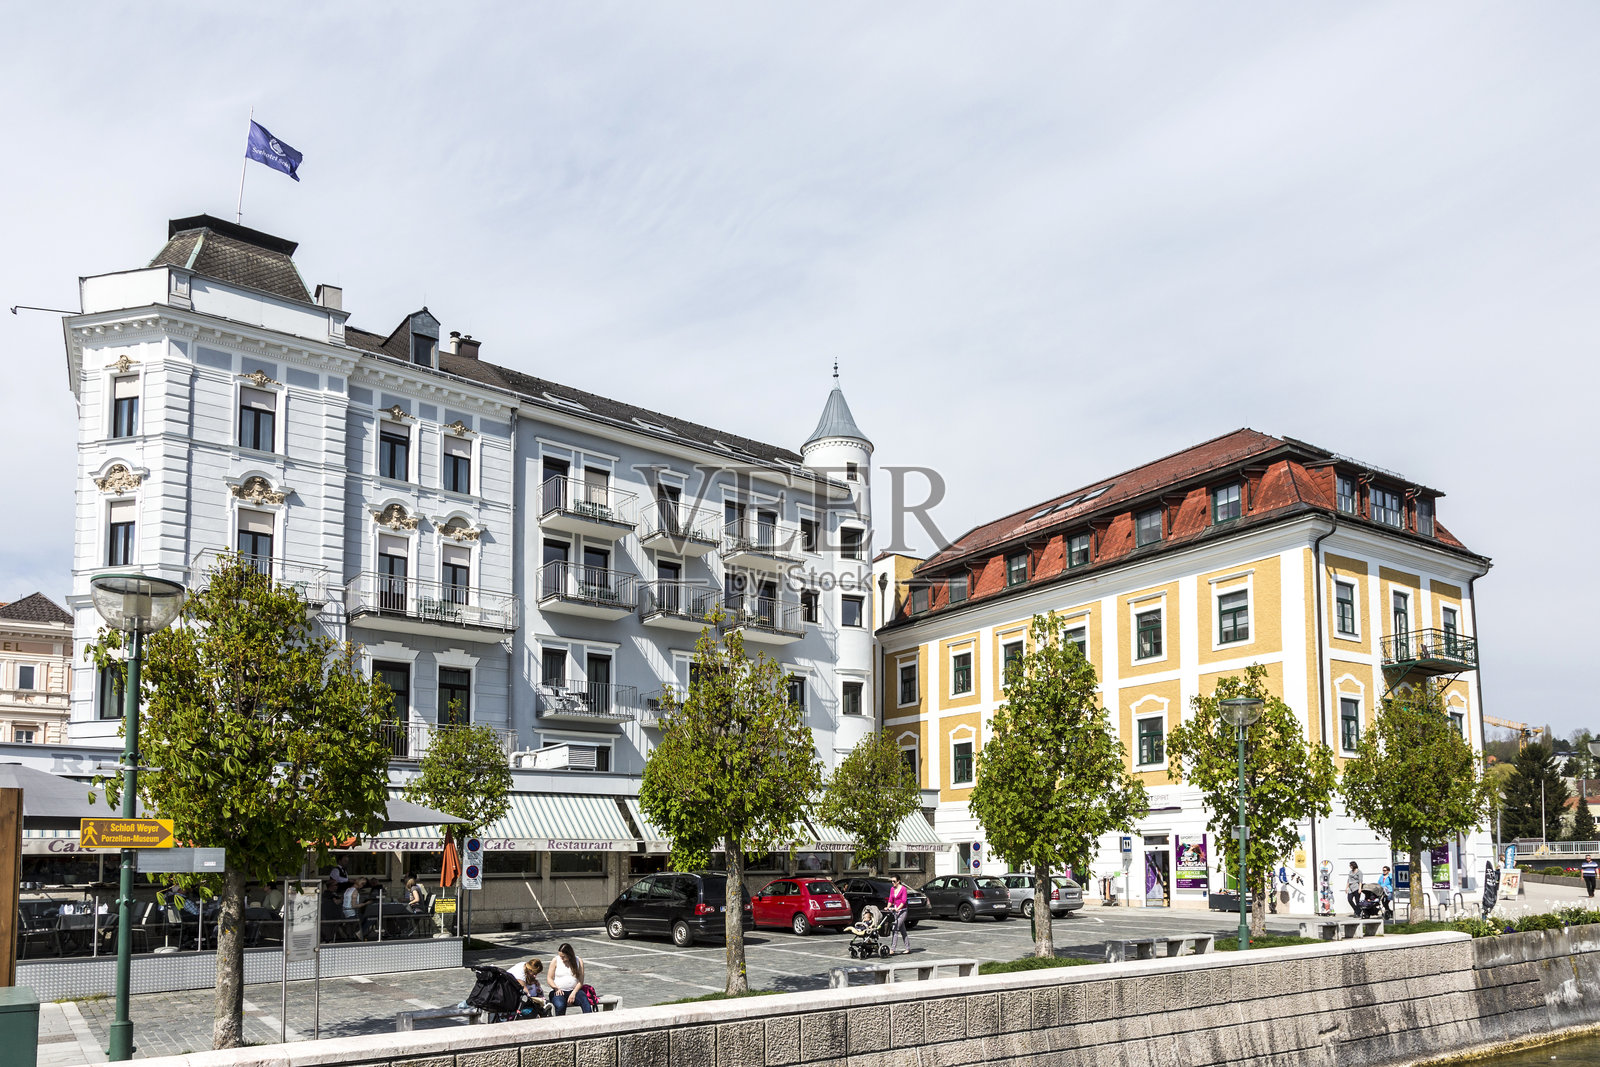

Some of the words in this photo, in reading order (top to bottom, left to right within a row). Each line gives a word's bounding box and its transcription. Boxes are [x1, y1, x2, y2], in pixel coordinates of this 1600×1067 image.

[252, 146, 278, 161] Seehotel
[110, 823, 135, 833] Schloß
[137, 824, 159, 834] Weyer
[101, 834, 160, 843] Porzellan-Museum
[368, 838, 444, 850] Restauran
[484, 838, 516, 850] Cafe
[547, 839, 613, 850] Restaurant
[815, 842, 856, 851] Restauran
